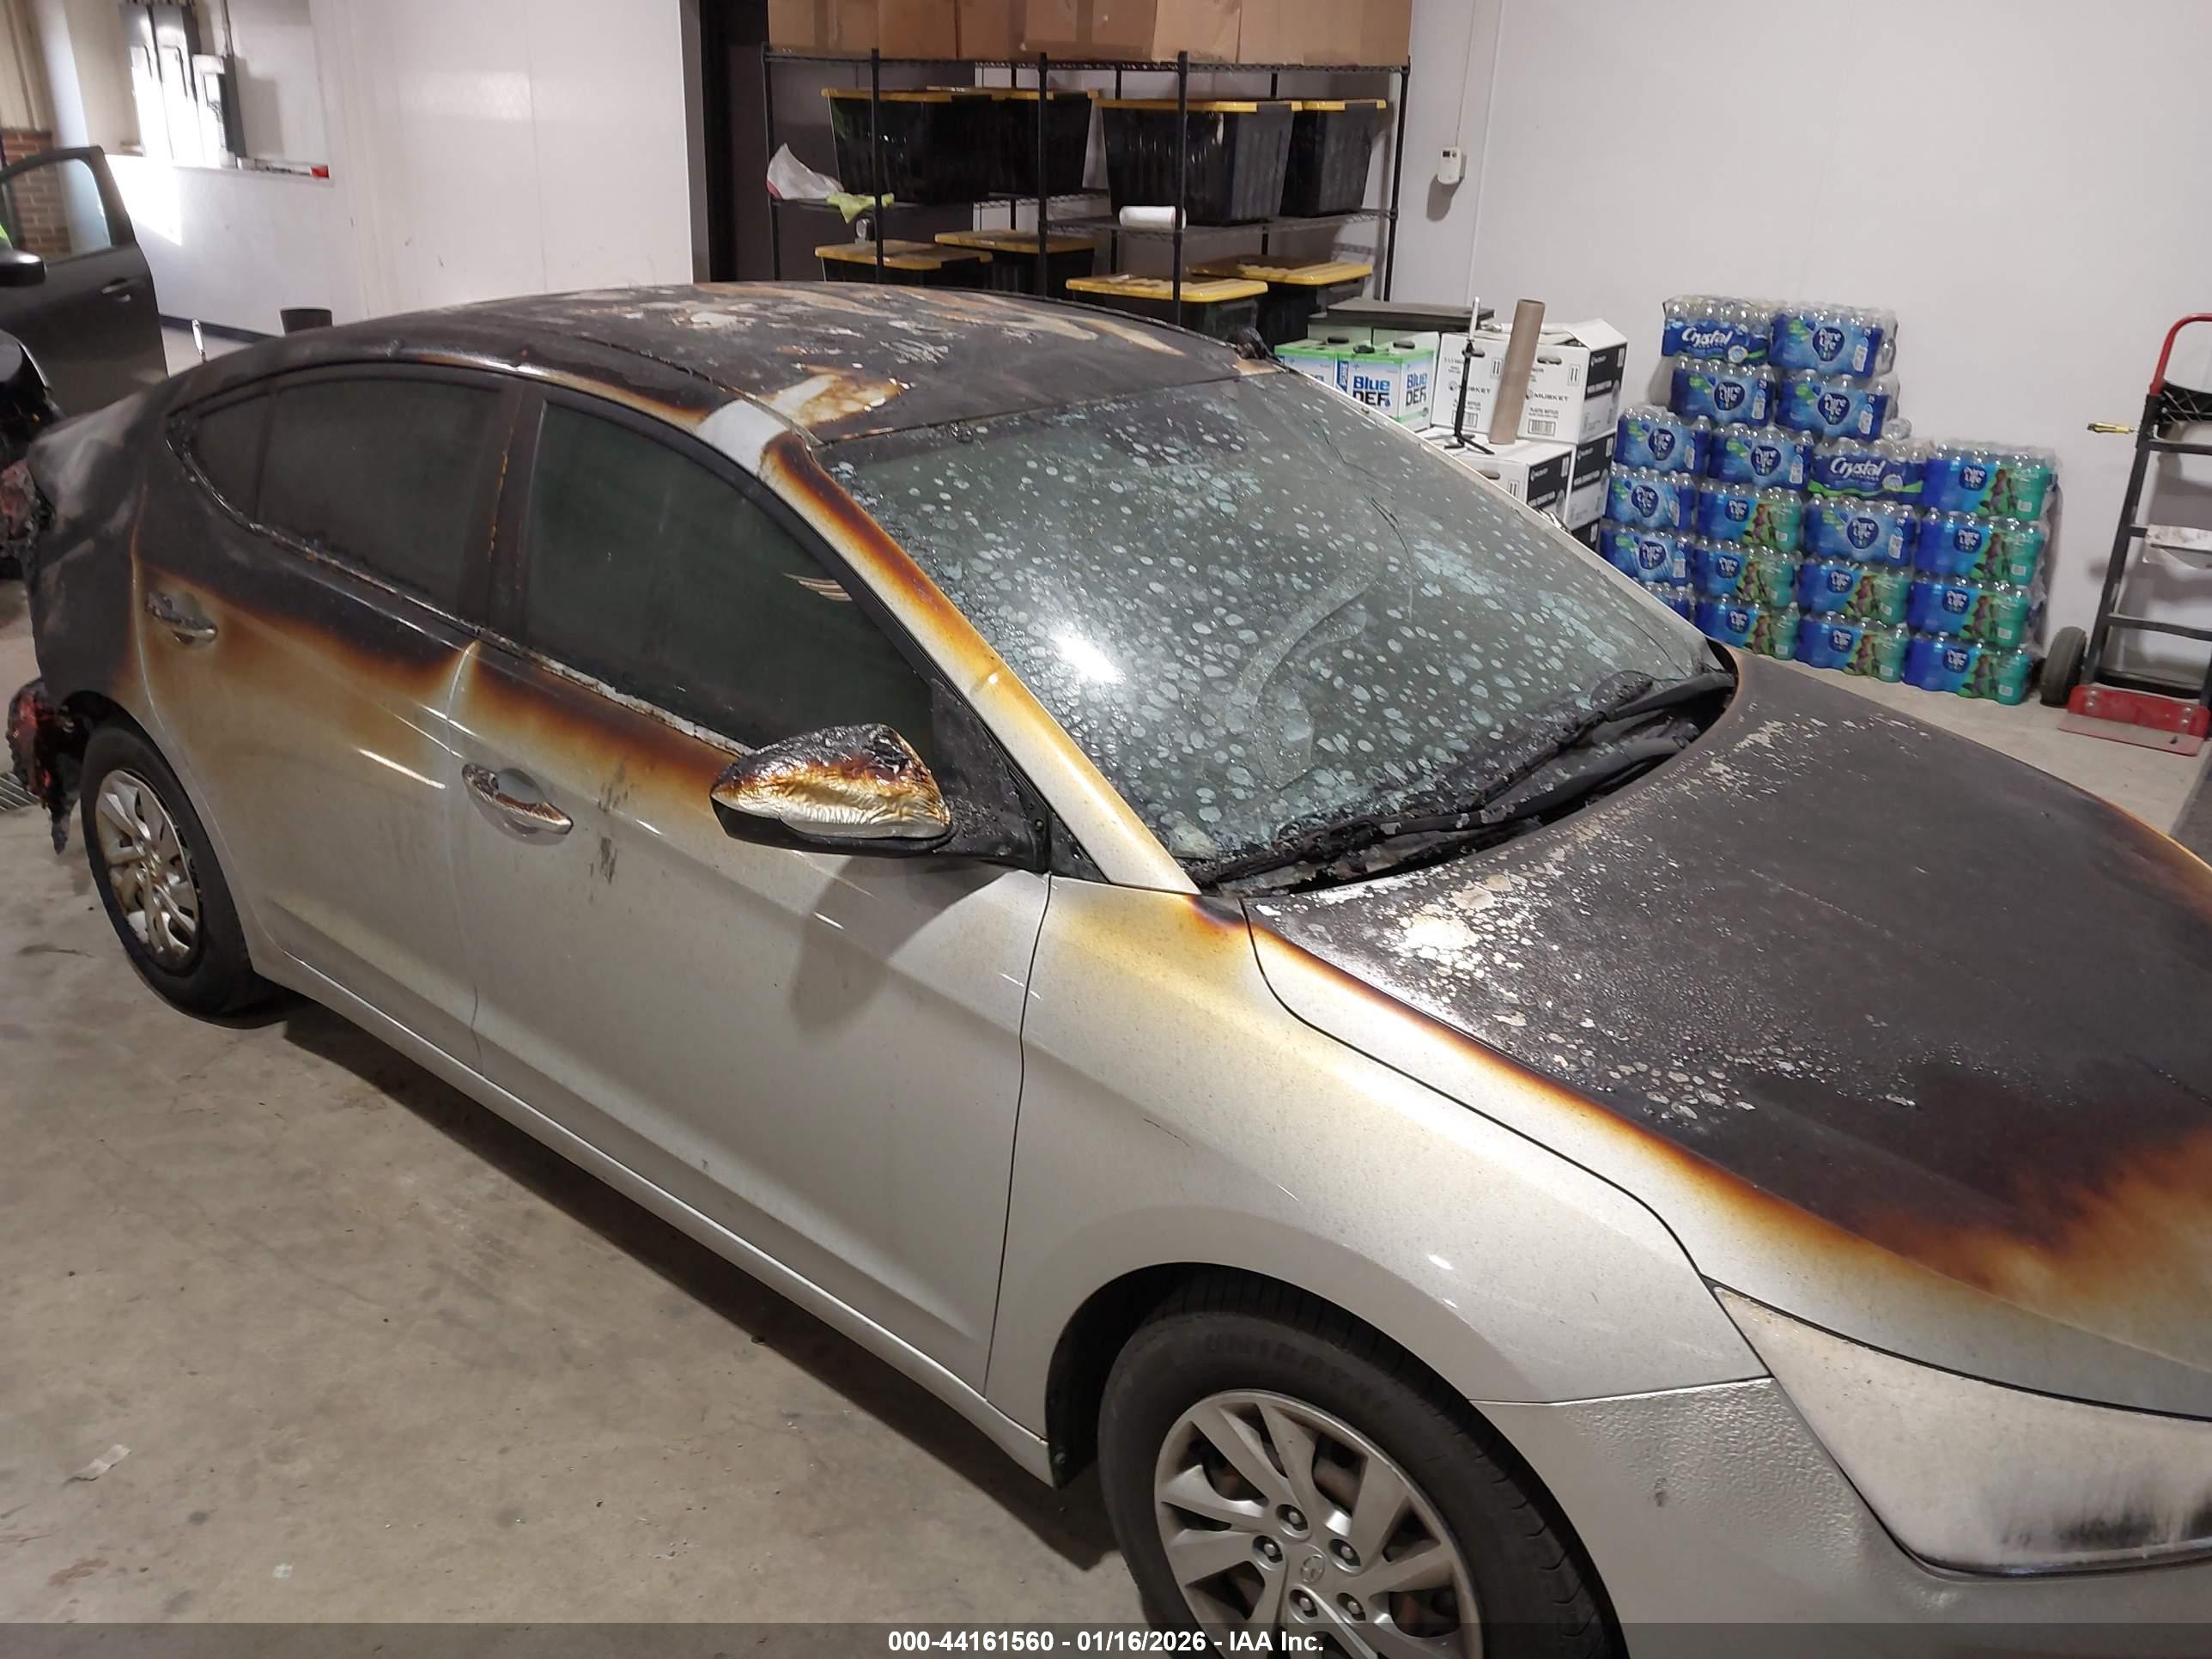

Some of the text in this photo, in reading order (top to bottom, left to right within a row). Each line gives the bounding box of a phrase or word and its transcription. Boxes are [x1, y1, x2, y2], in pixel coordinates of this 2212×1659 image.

[1682, 327, 1734, 349] Crystal
[1353, 375, 1391, 391] Blue
[1407, 371, 1428, 389] Blue
[1406, 386, 1427, 406] DEF
[1830, 457, 1887, 478] Crystal
